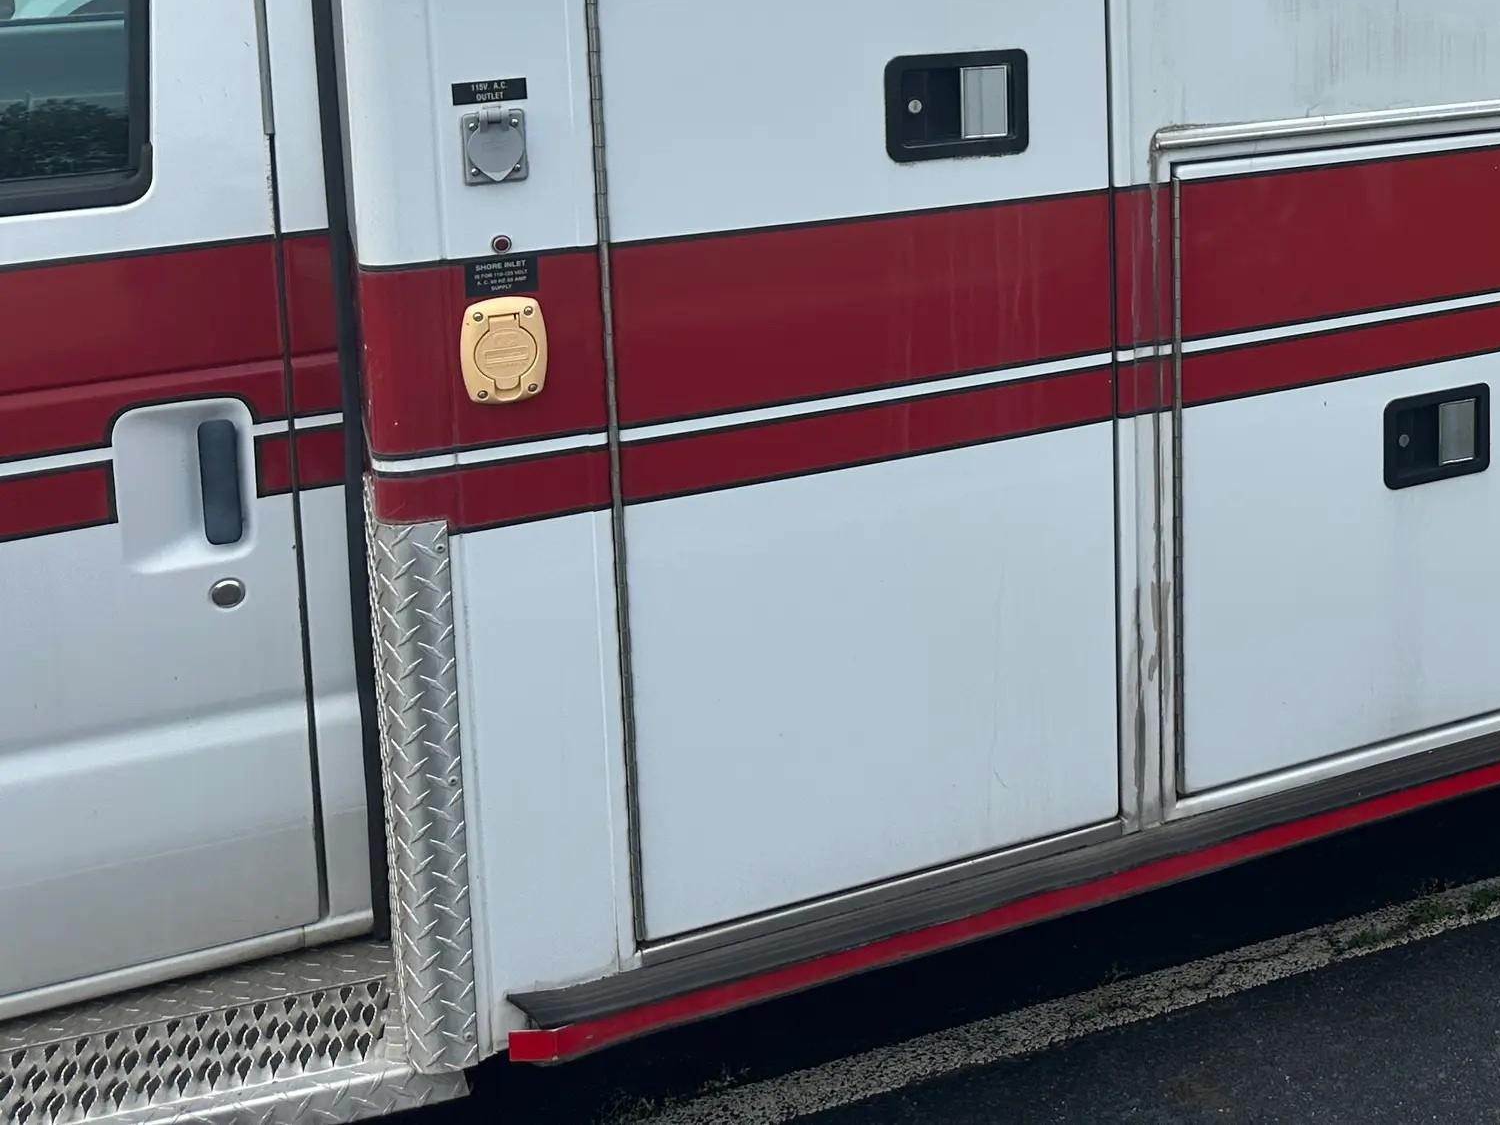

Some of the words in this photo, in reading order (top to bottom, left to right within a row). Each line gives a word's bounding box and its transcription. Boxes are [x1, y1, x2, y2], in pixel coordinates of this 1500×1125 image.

[476, 92, 504, 101] OUTLET
[475, 262, 502, 272] SHORE
[504, 259, 526, 268] INLET
[491, 283, 512, 291] SUPPLY
